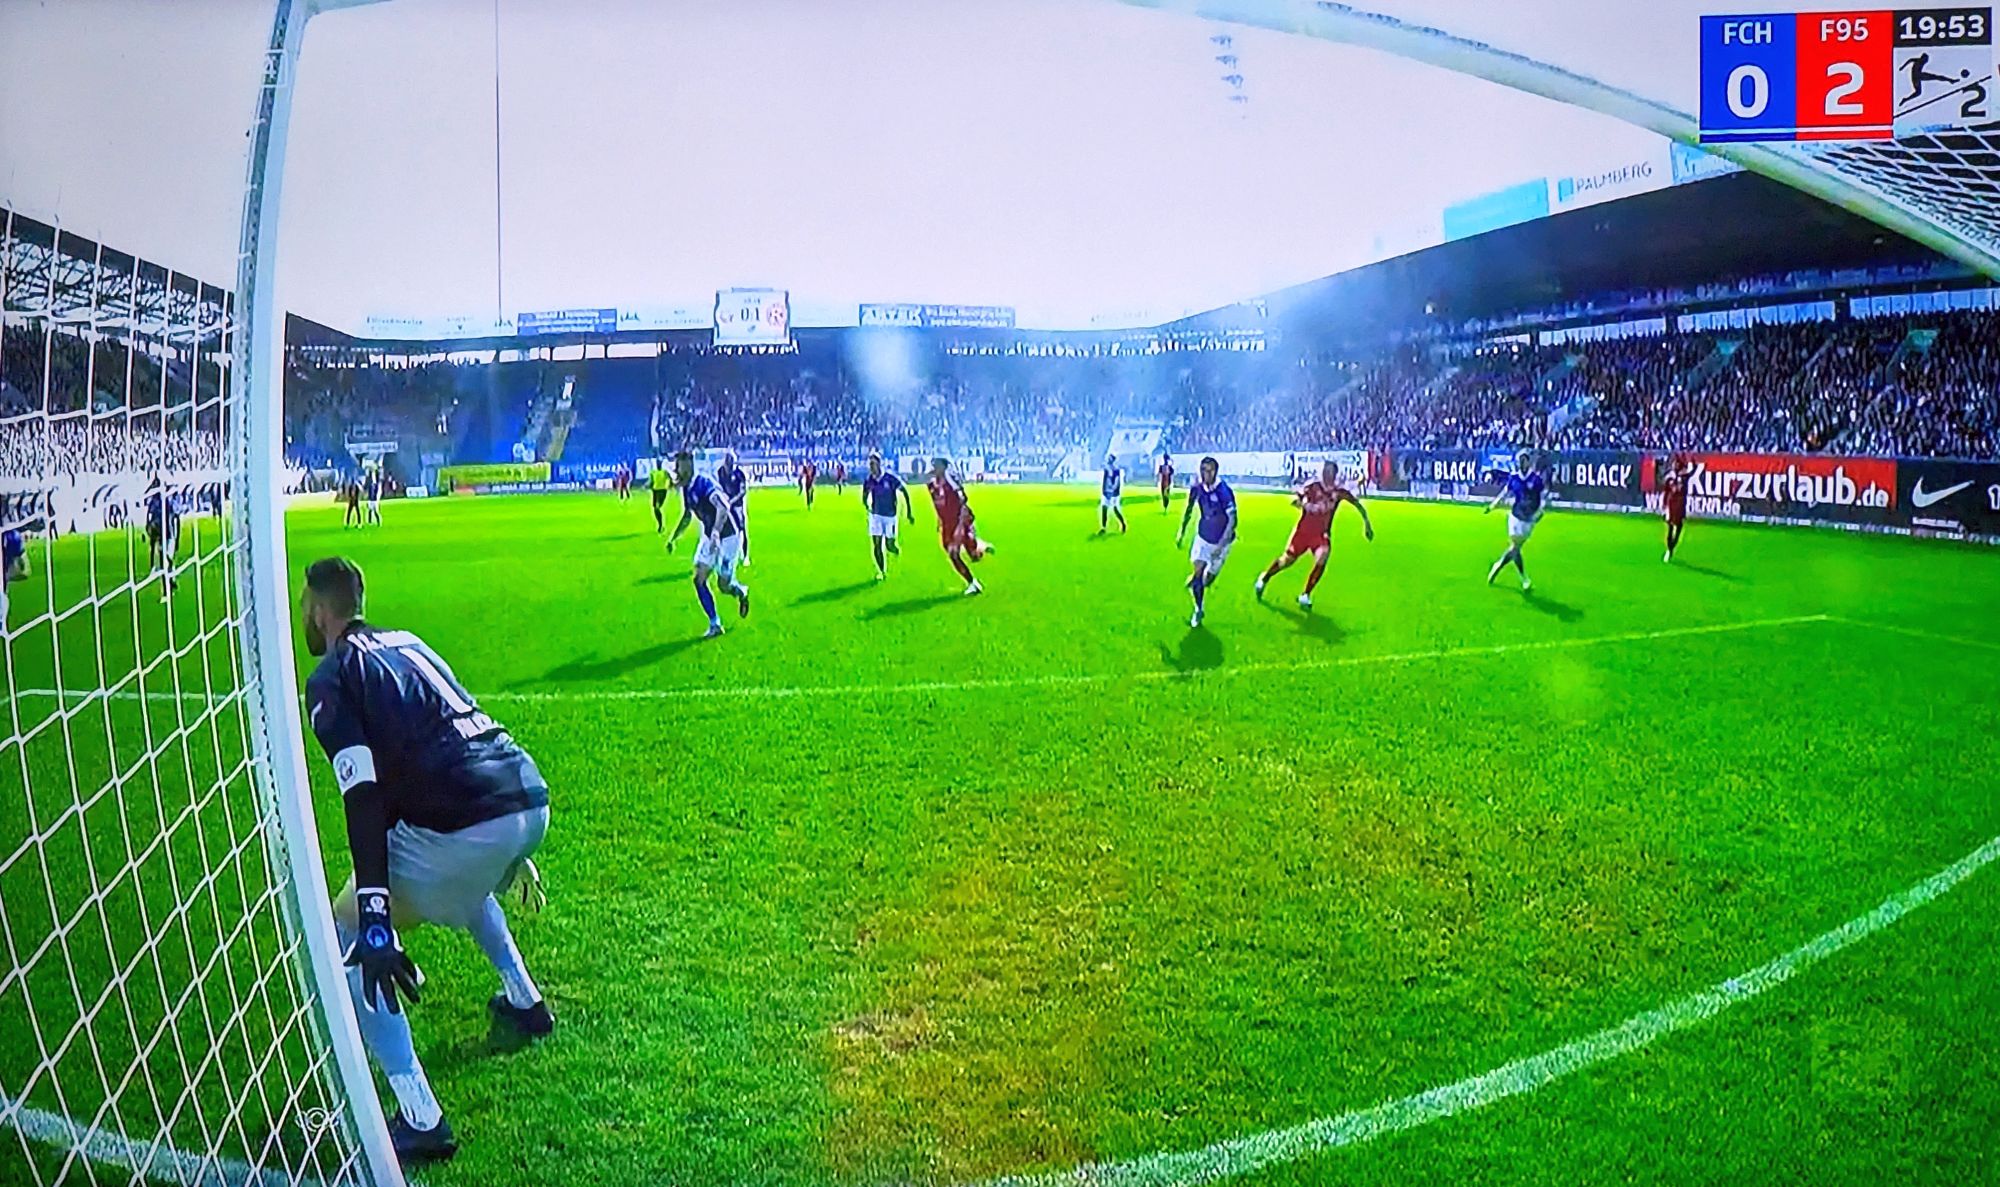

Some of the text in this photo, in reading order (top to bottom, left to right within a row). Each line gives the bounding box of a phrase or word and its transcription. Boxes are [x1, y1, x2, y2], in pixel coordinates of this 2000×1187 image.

[1576, 161, 1653, 192] PALMBERG
[1434, 460, 1477, 482] BLACK
[1576, 462, 1632, 489] BLACK
[1686, 460, 1889, 509] Kurzurlaub.de
